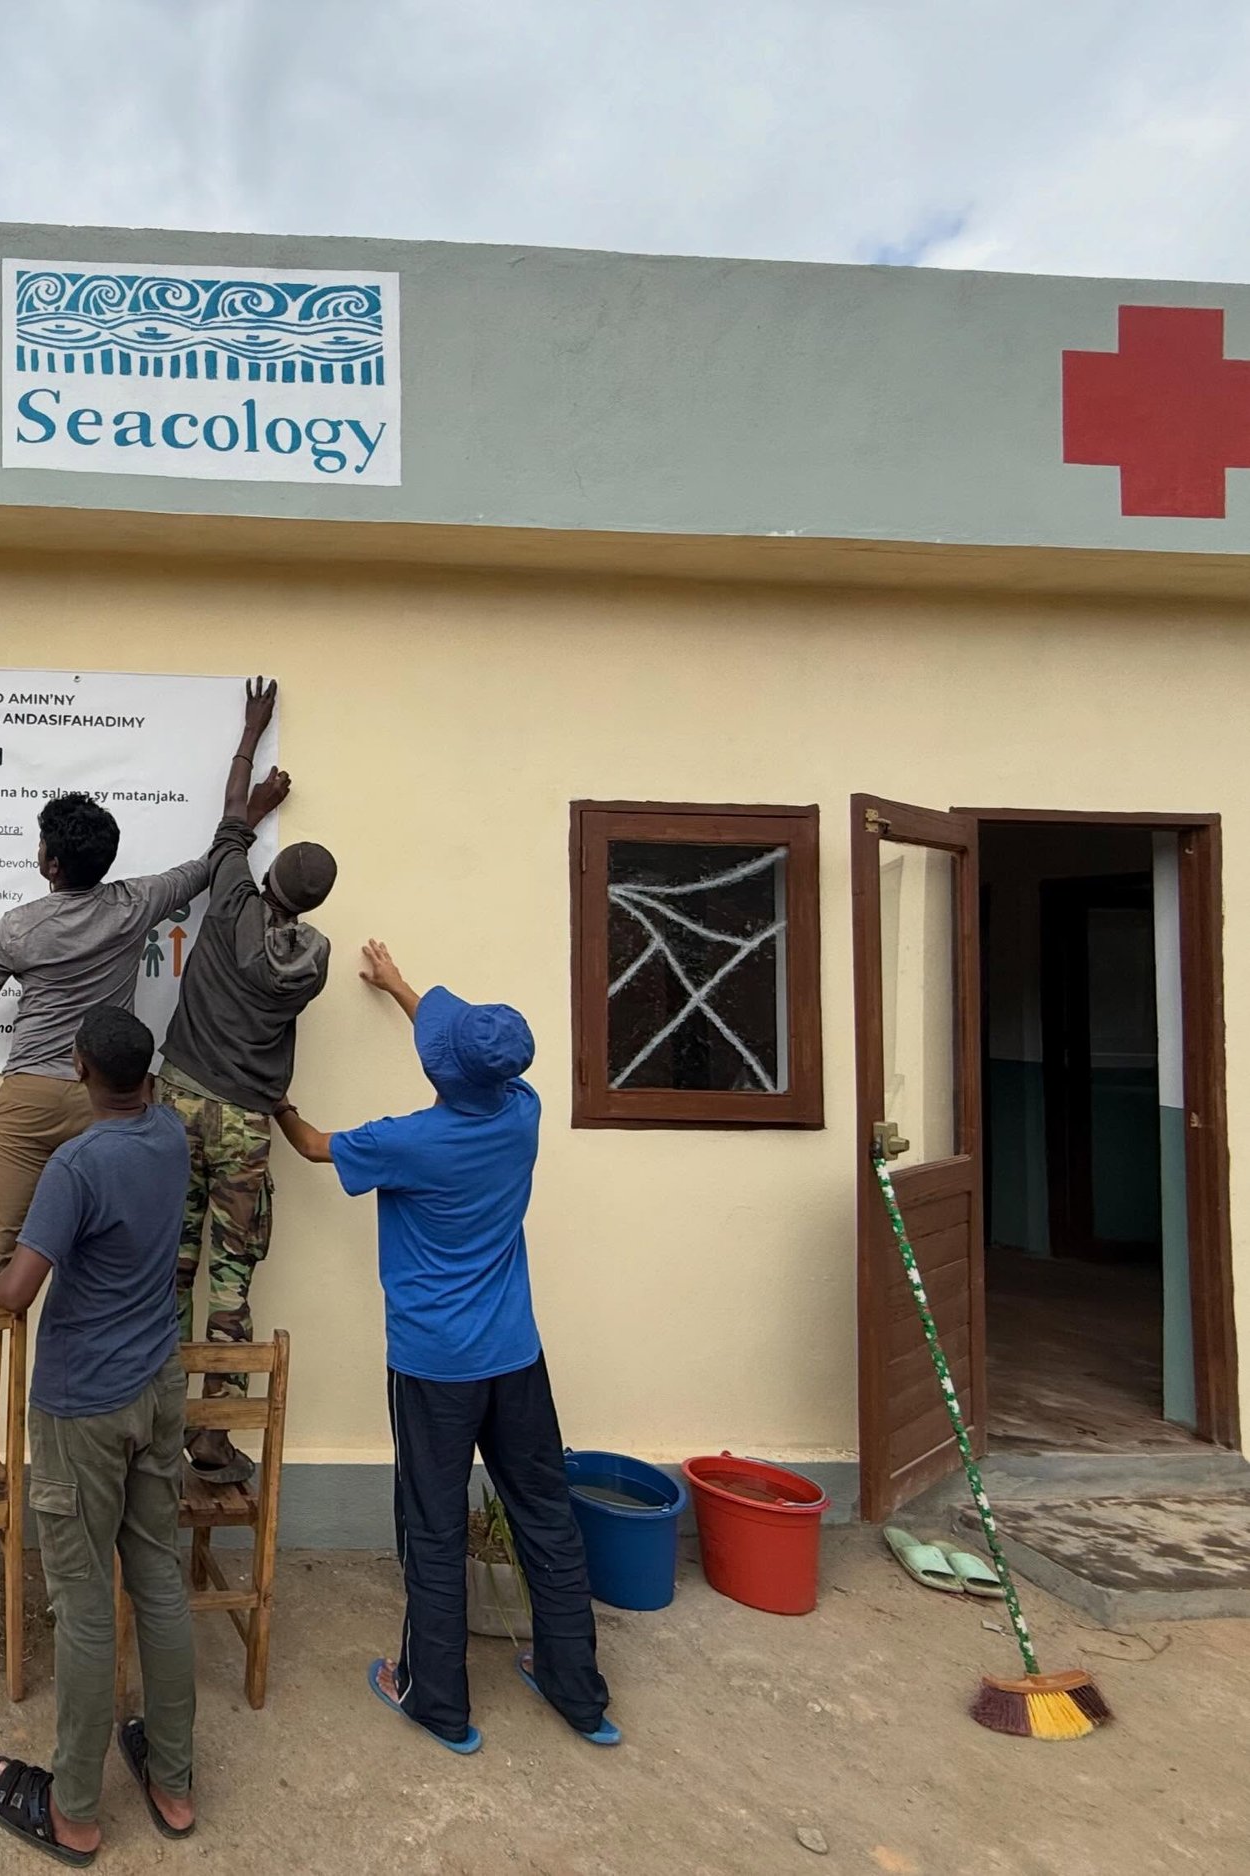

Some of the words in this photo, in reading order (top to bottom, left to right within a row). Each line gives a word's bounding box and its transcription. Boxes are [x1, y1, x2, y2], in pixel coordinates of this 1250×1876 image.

[16, 388, 387, 474] Seacology
[8, 693, 75, 706] AMIN'NY
[3, 712, 145, 728] ANDASIFAHADIMY
[21, 786, 38, 798] ho
[94, 790, 109, 803] sy
[113, 790, 189, 804] matanjaka.
